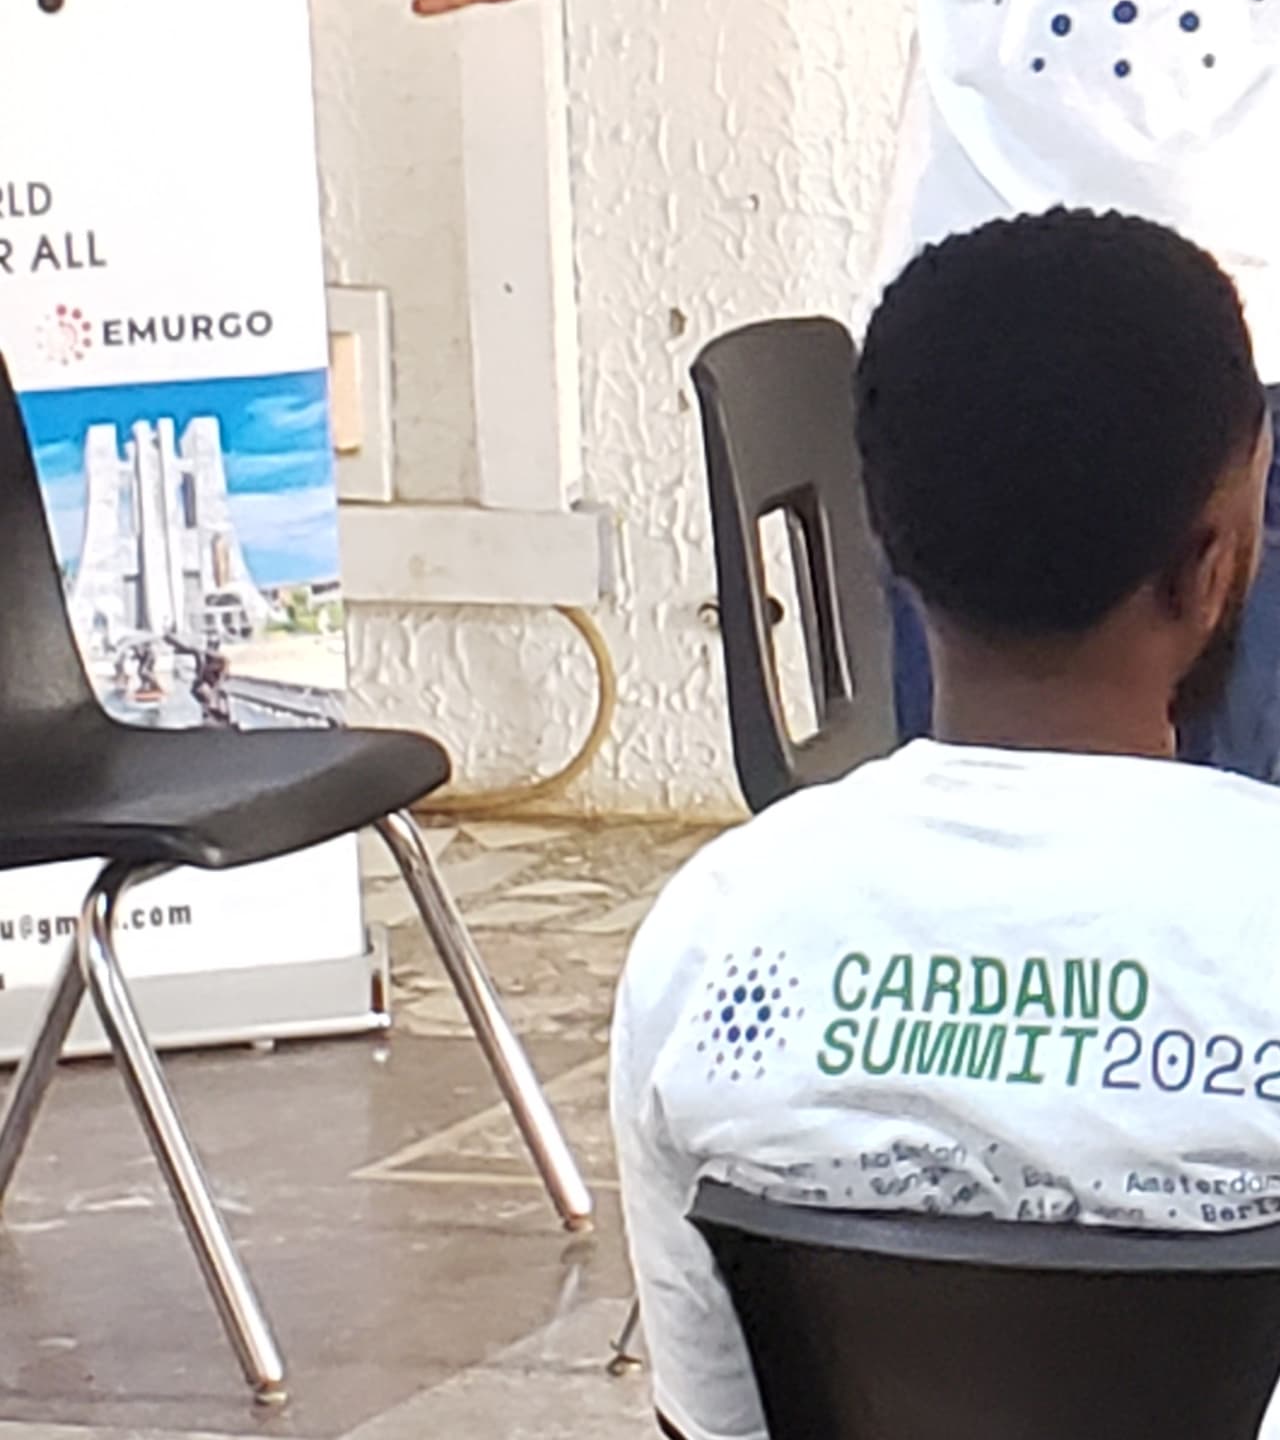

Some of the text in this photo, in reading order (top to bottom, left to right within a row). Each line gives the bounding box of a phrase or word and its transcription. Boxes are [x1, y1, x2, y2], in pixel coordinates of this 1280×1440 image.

[30, 229, 108, 273] ALL
[102, 311, 274, 346] EMURGO
[0, 905, 192, 944] u@gm.com
[832, 951, 1149, 1022] CARDANO
